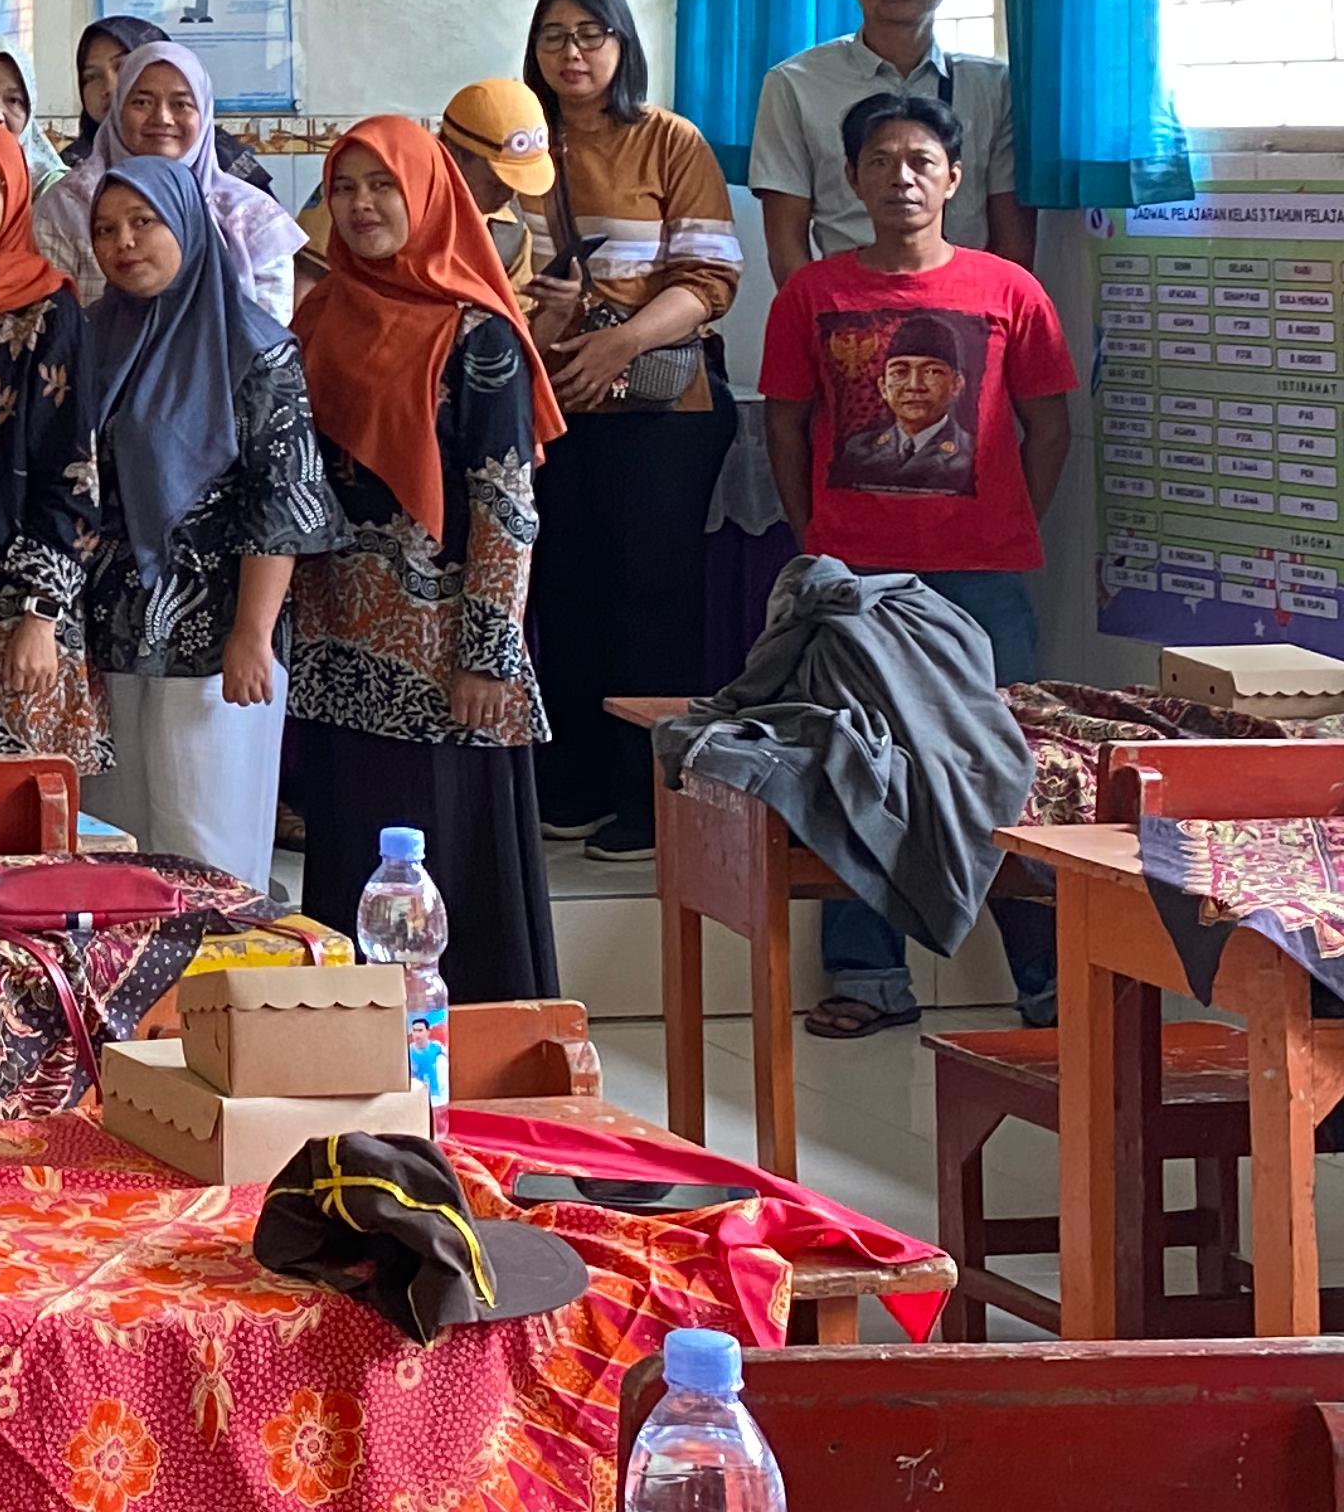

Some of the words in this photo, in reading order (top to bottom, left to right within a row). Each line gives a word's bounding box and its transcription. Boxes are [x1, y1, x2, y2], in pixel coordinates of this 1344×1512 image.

[1171, 207, 1226, 222] PELAJARAN
[1228, 207, 1258, 222] KELAS
[1269, 207, 1303, 223] TAHUN
[1276, 379, 1338, 395] ISTIRAHAT
